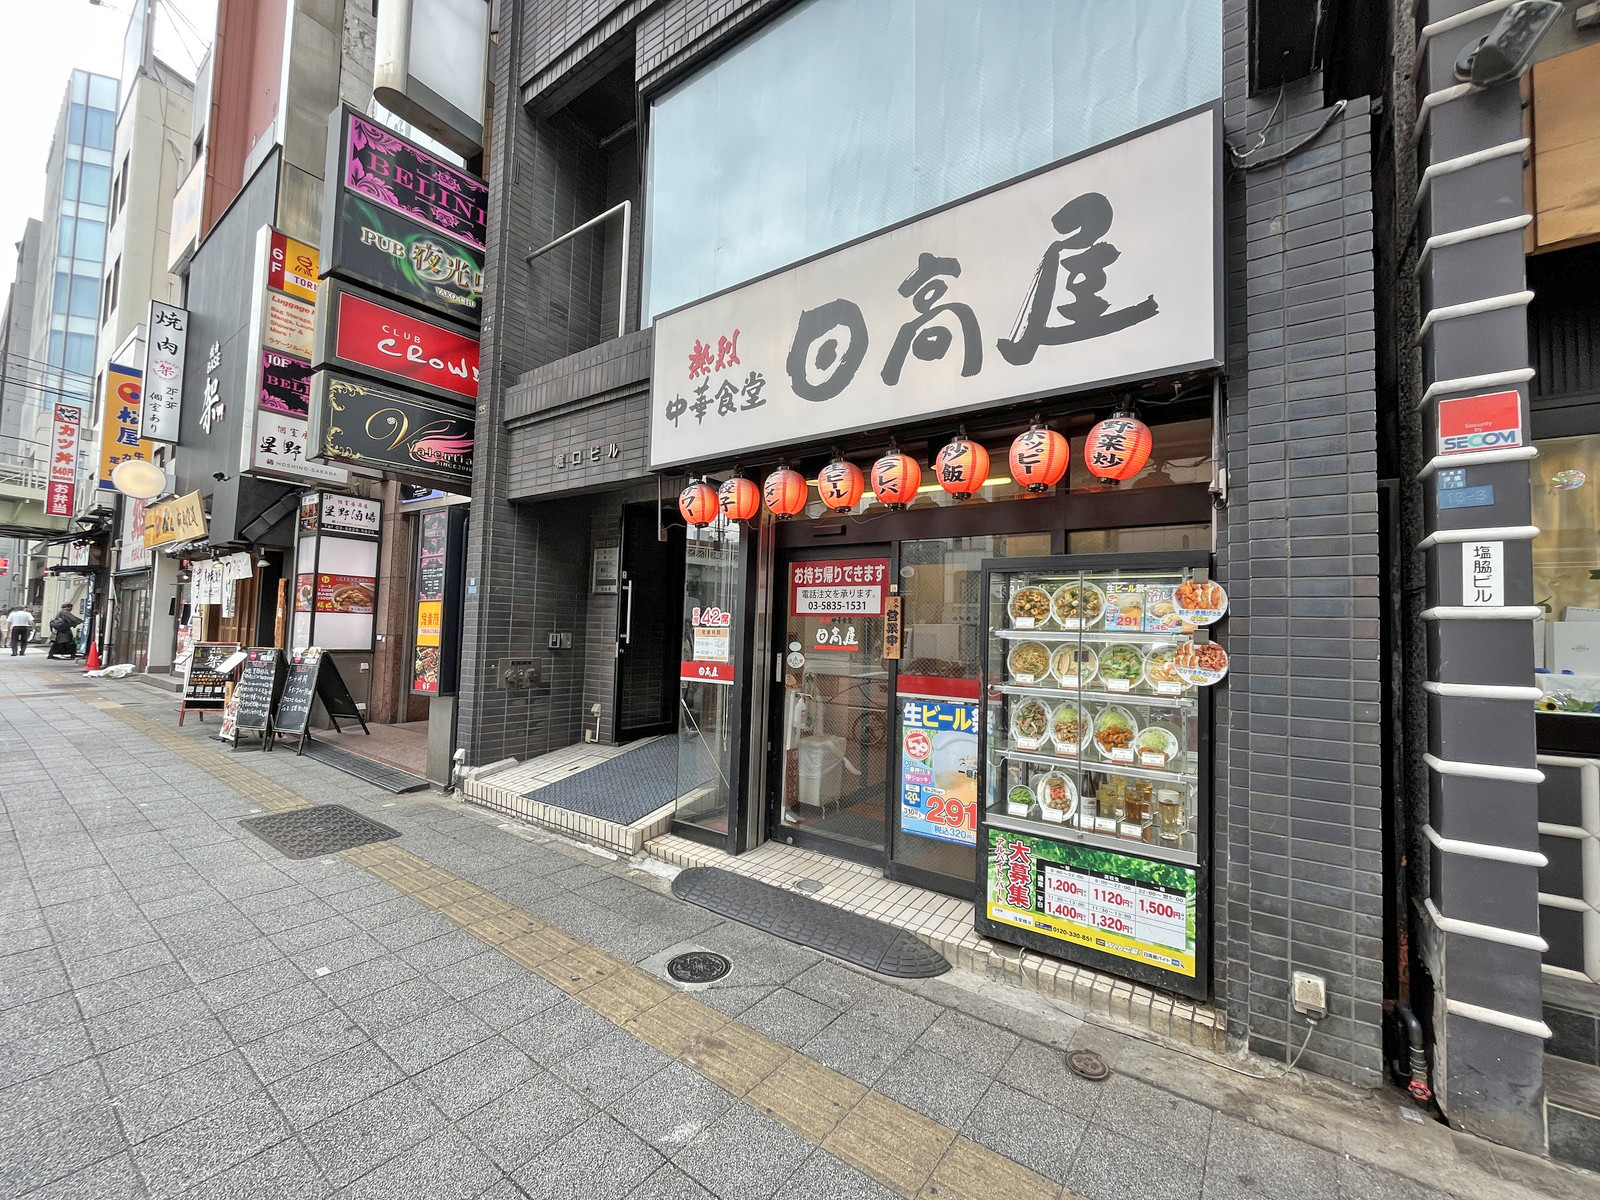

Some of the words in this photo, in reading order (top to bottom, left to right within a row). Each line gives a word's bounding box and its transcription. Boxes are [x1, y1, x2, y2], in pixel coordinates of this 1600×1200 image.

[360, 225, 406, 259] PUB
[271, 295, 310, 315] Luggage
[785, 191, 1161, 404] 日高屋
[155, 310, 184, 356] 焼肉
[269, 320, 297, 333] Shower
[269, 326, 287, 337] More
[381, 324, 421, 343] CLUB
[688, 328, 741, 380] 熱烈
[664, 371, 768, 430] 中華食堂
[1464, 421, 1493, 429] Security
[55, 424, 76, 465] カツ丼
[260, 436, 303, 461] 星野
[1091, 419, 1135, 469] 野菜炒
[1444, 430, 1516, 450] SECOM
[940, 441, 968, 484] 炒飯
[1017, 429, 1047, 475] ホッピー
[824, 461, 848, 500] 生ビール
[51, 483, 69, 514] お弁当
[718, 480, 736, 513] 餃子
[324, 504, 377, 523] 星野酒場
[794, 564, 886, 584] お持ち帰りできます
[1473, 545, 1493, 603] 塩脇ビル
[801, 588, 876, 599] 電話注文を承ります。
[808, 601, 867, 611] 03-5835-1531
[815, 625, 859, 646] 日高屋
[886, 609, 899, 646] 営業中
[698, 666, 719, 678] 日高屋
[925, 794, 977, 830] 291
[1008, 841, 1032, 908] 大募集
[1047, 877, 1084, 897] 1,200円
[1047, 901, 1084, 921] 1,400円
[1139, 899, 1181, 920] 1,500円
[1090, 912, 1130, 933] 1,320円
[1052, 926, 1093, 943] 0120-330-851
